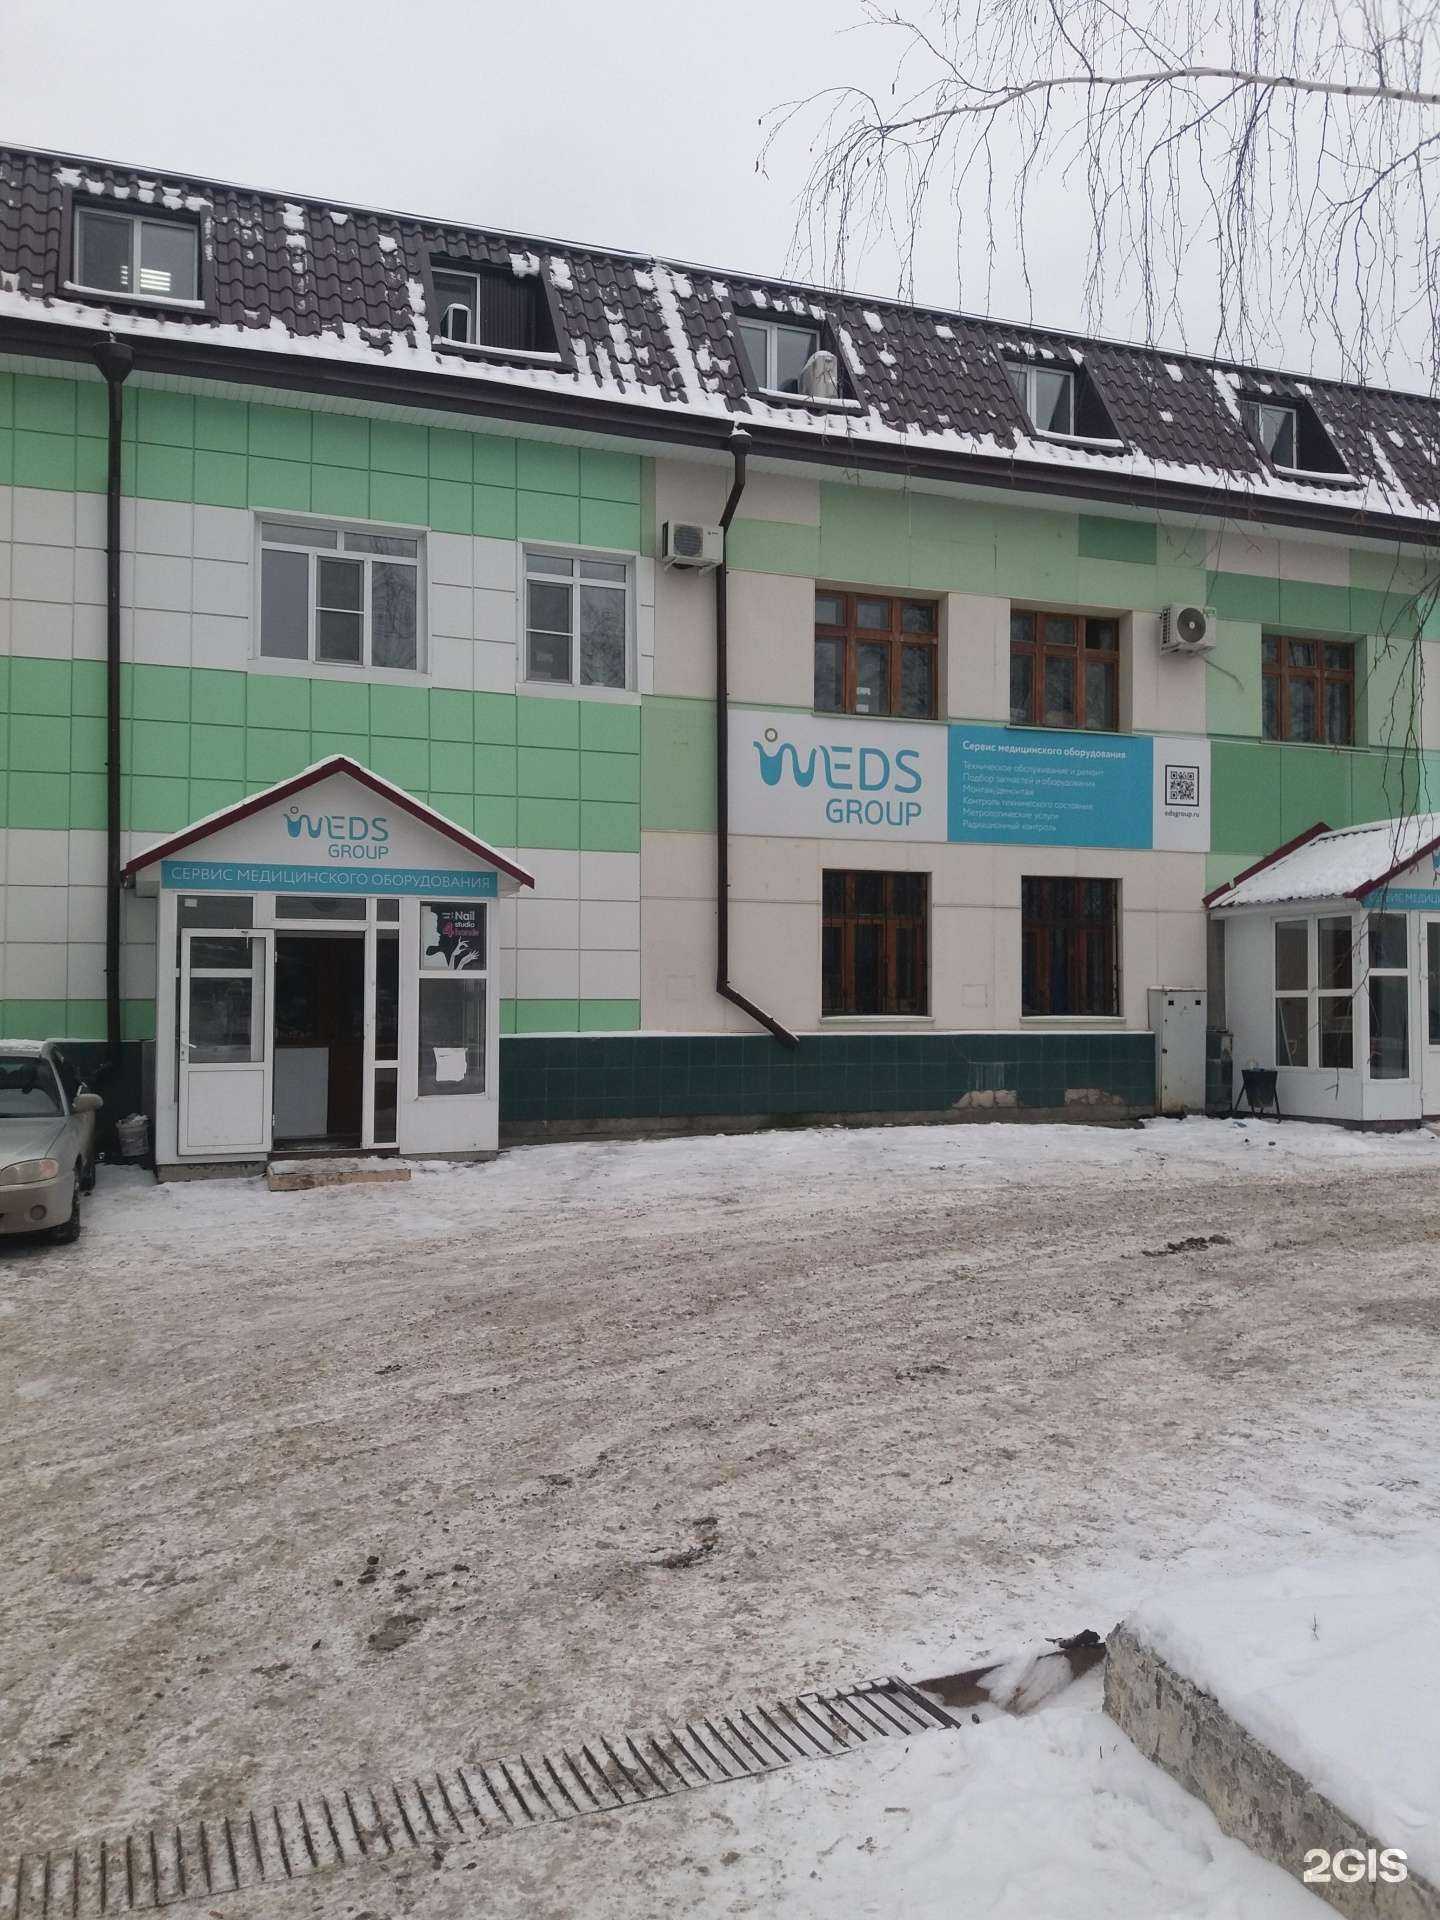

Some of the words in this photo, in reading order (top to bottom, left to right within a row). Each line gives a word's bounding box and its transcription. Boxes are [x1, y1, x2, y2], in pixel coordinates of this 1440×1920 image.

[962, 740, 997, 752] Сервис
[1063, 747, 1127, 759] оборудования
[826, 798, 922, 827] GROUP
[328, 844, 389, 859] GROUP
[171, 867, 233, 881] СЕРВИС
[237, 870, 369, 885] МЕДИЦИНСКОГО
[371, 873, 490, 889] ОБОРУДОВАНИЯ
[454, 911, 475, 921] Nail
